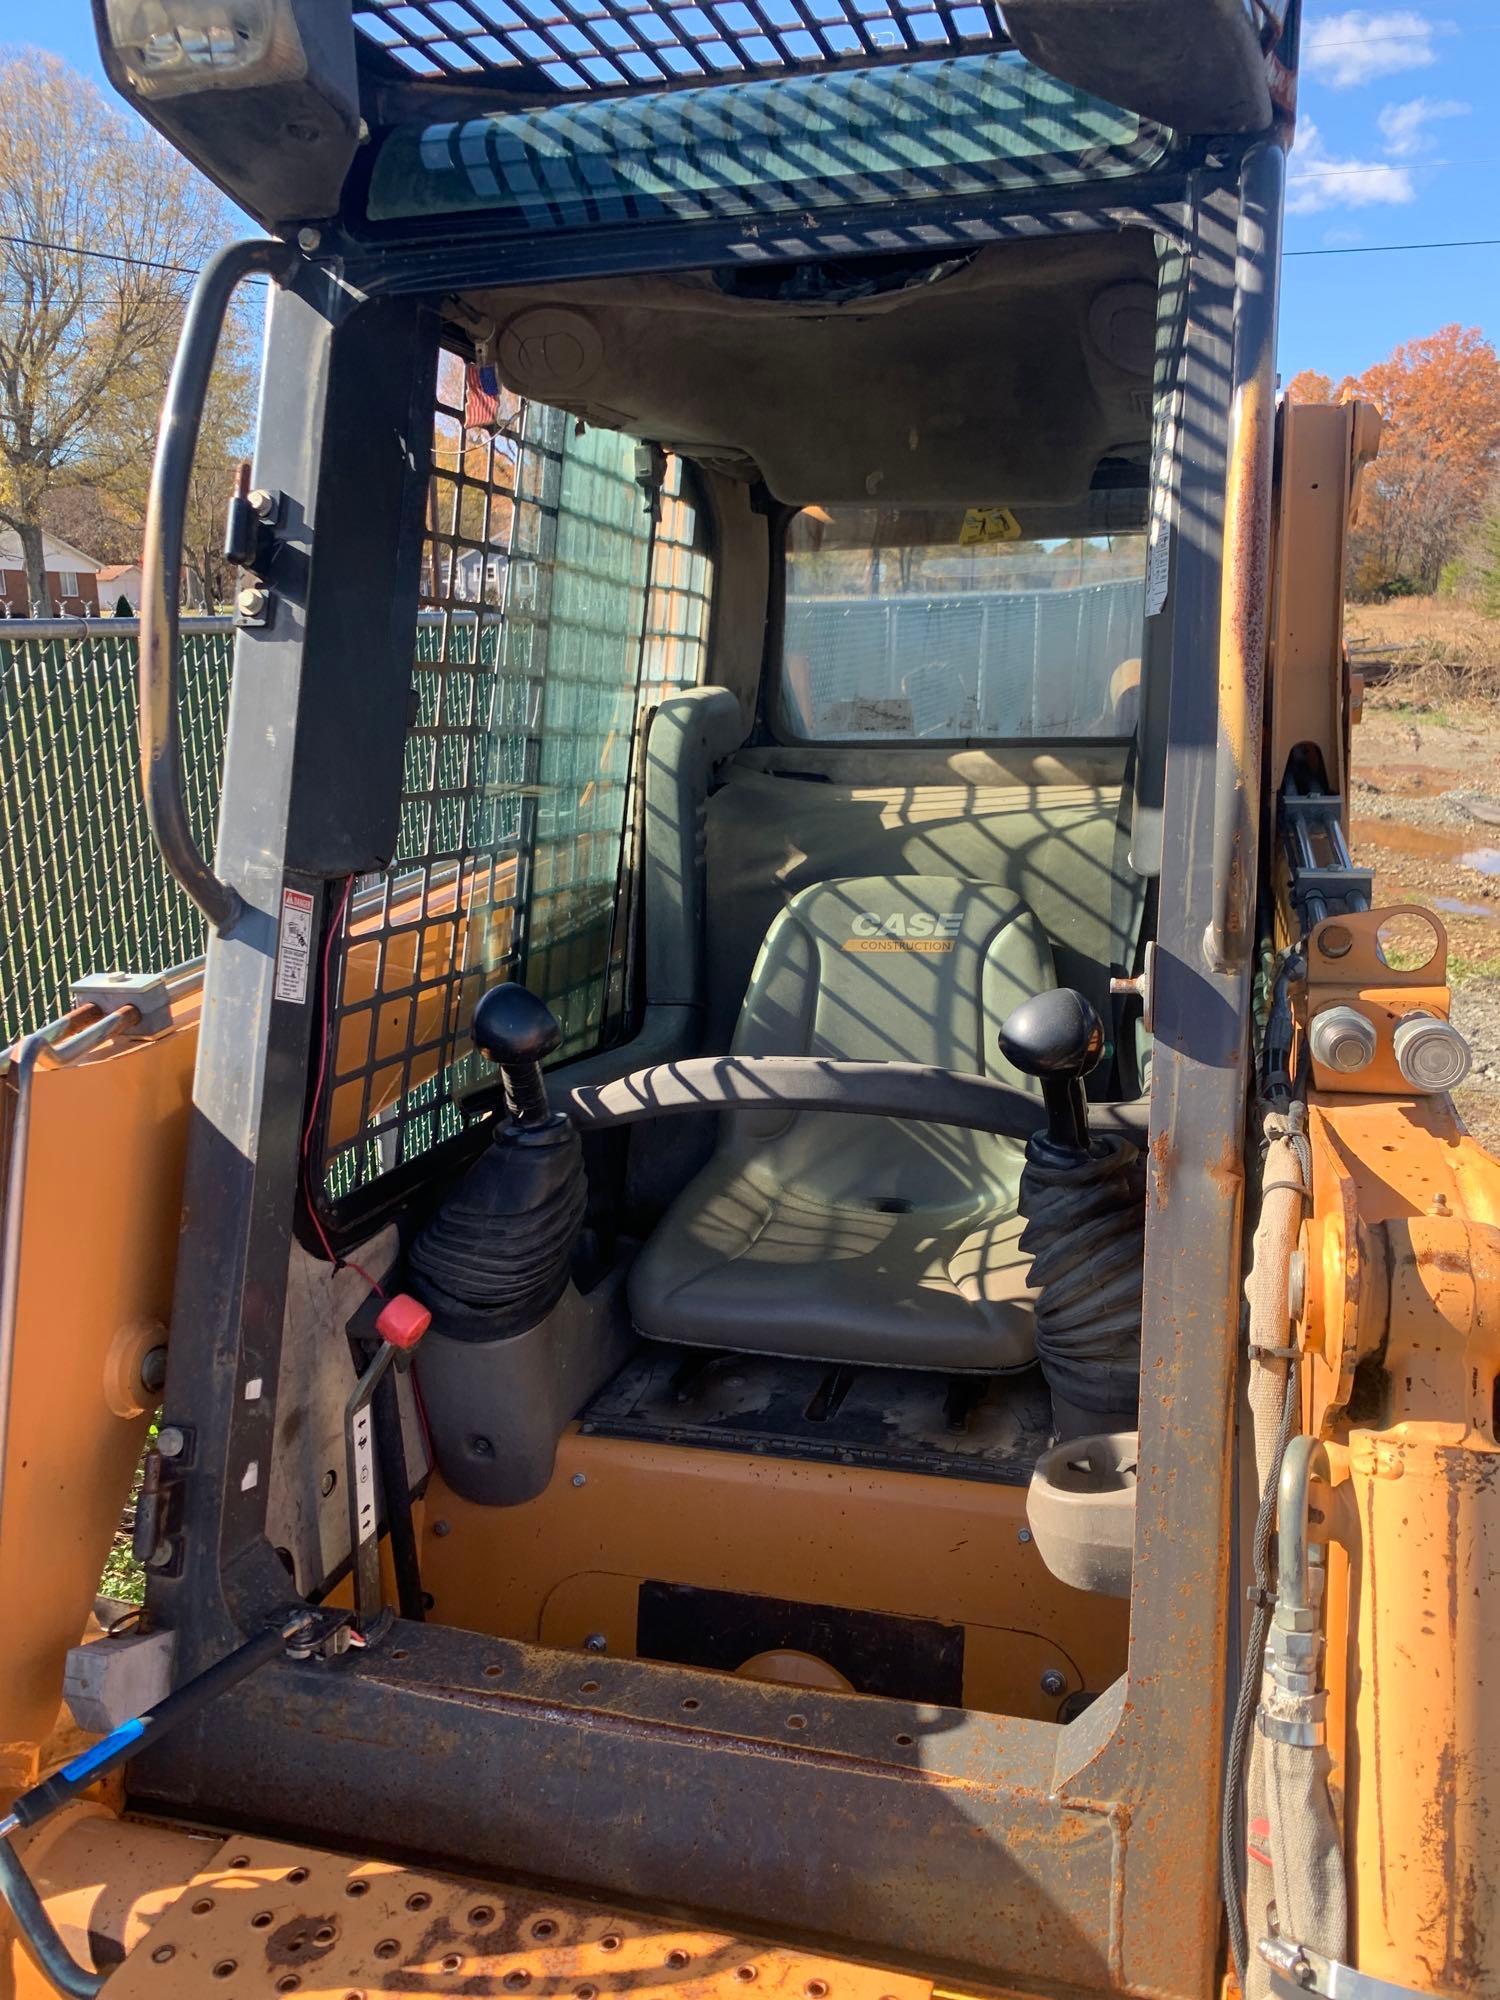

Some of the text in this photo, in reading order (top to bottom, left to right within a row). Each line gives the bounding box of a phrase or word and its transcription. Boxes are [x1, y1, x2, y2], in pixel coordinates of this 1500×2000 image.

[293, 896, 311, 908] DANGER
[851, 912, 964, 937] CASE
[860, 941, 951, 951] CONSTRUCTION
